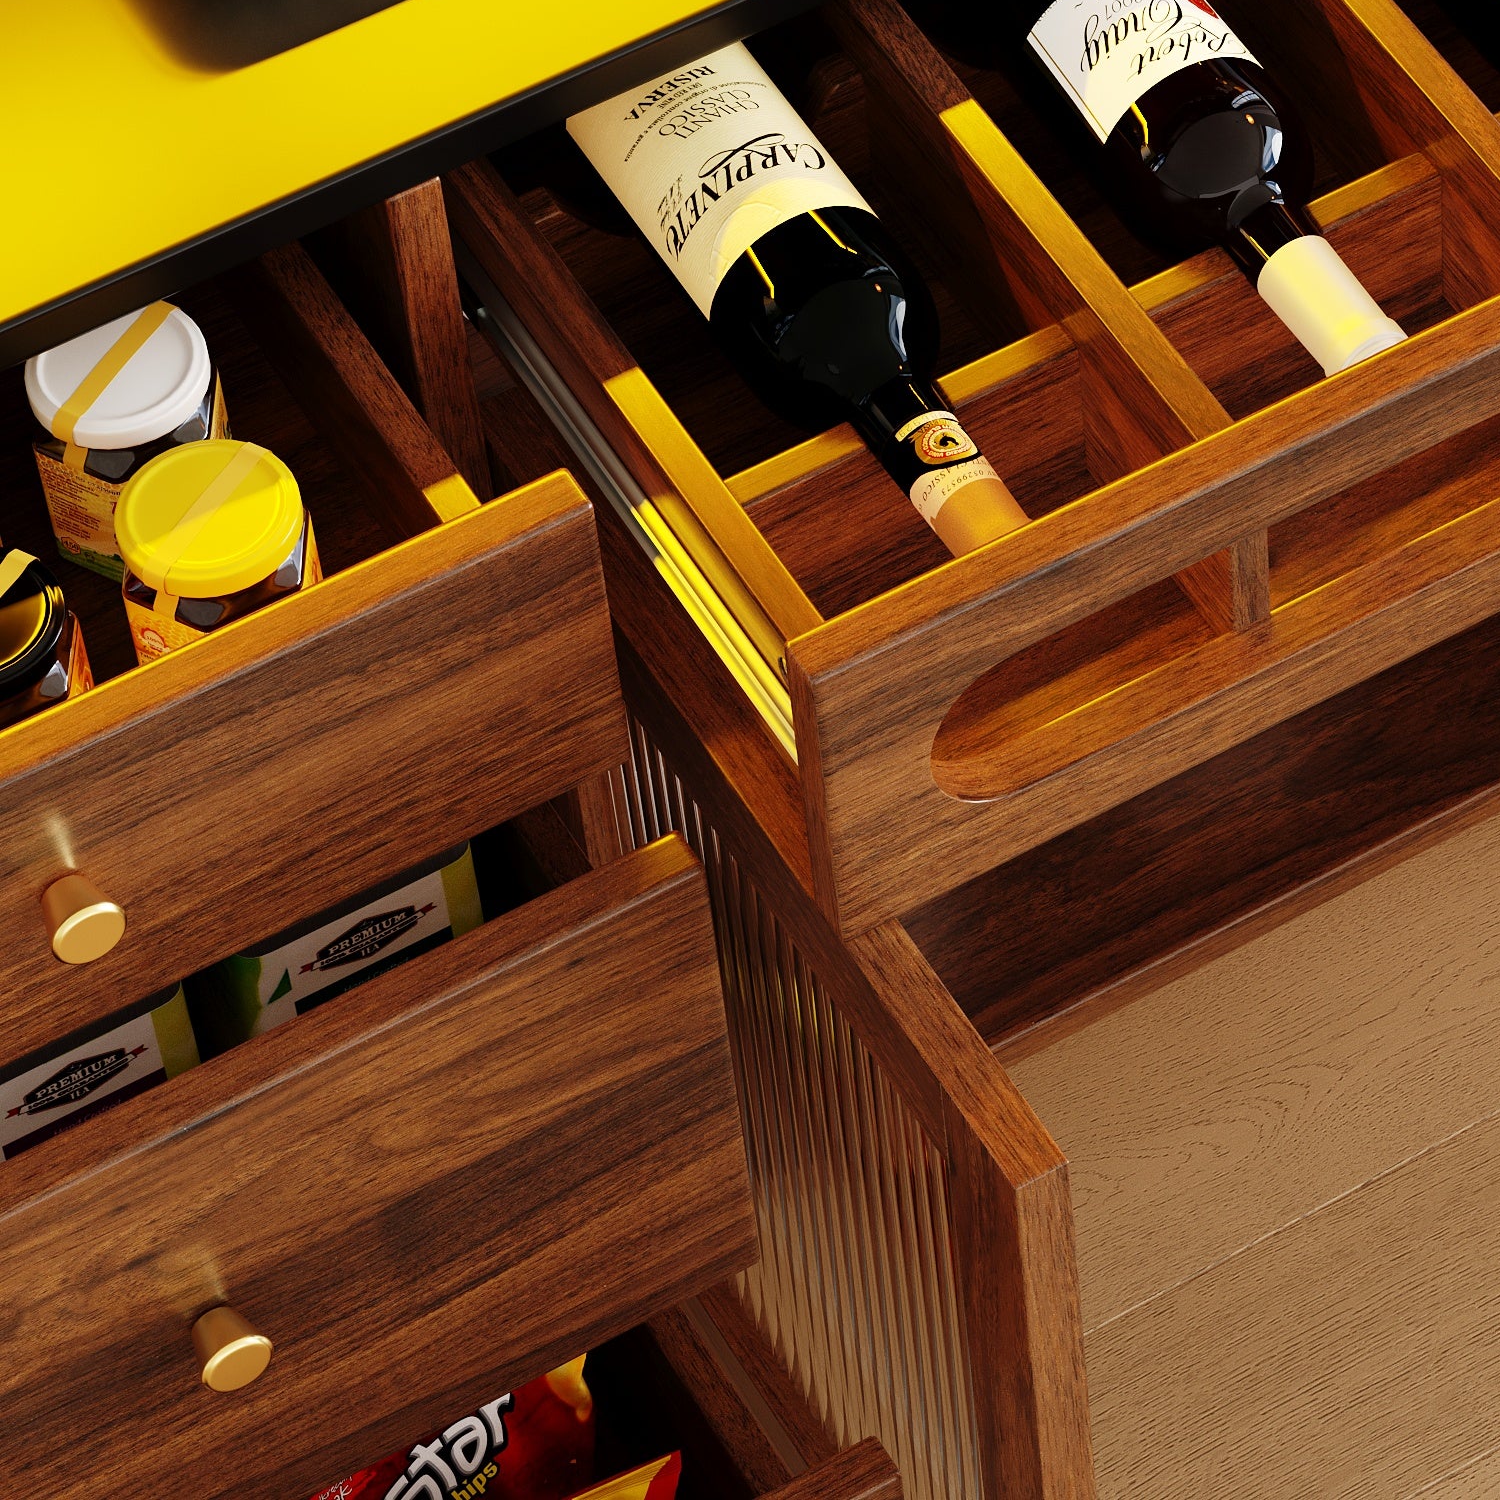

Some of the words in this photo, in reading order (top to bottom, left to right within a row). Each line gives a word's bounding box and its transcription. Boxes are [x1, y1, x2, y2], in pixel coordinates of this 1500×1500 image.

[1126, 15, 1247, 83] Robert
[623, 65, 716, 121] RISERVA
[656, 96, 673, 110] WINE
[684, 88, 709, 103] origine
[647, 100, 684, 131] controllata
[658, 89, 751, 137] CLASSICO
[673, 99, 760, 139] CHIANTI
[623, 133, 645, 162] garantita
[665, 132, 826, 263] CARPINETO
[941, 469, 984, 497] 05299573
[328, 912, 407, 955] PREMIUM
[360, 943, 380, 957] TEA
[35, 1054, 117, 1100] PREMIUM
[70, 1086, 91, 1100] TEA
